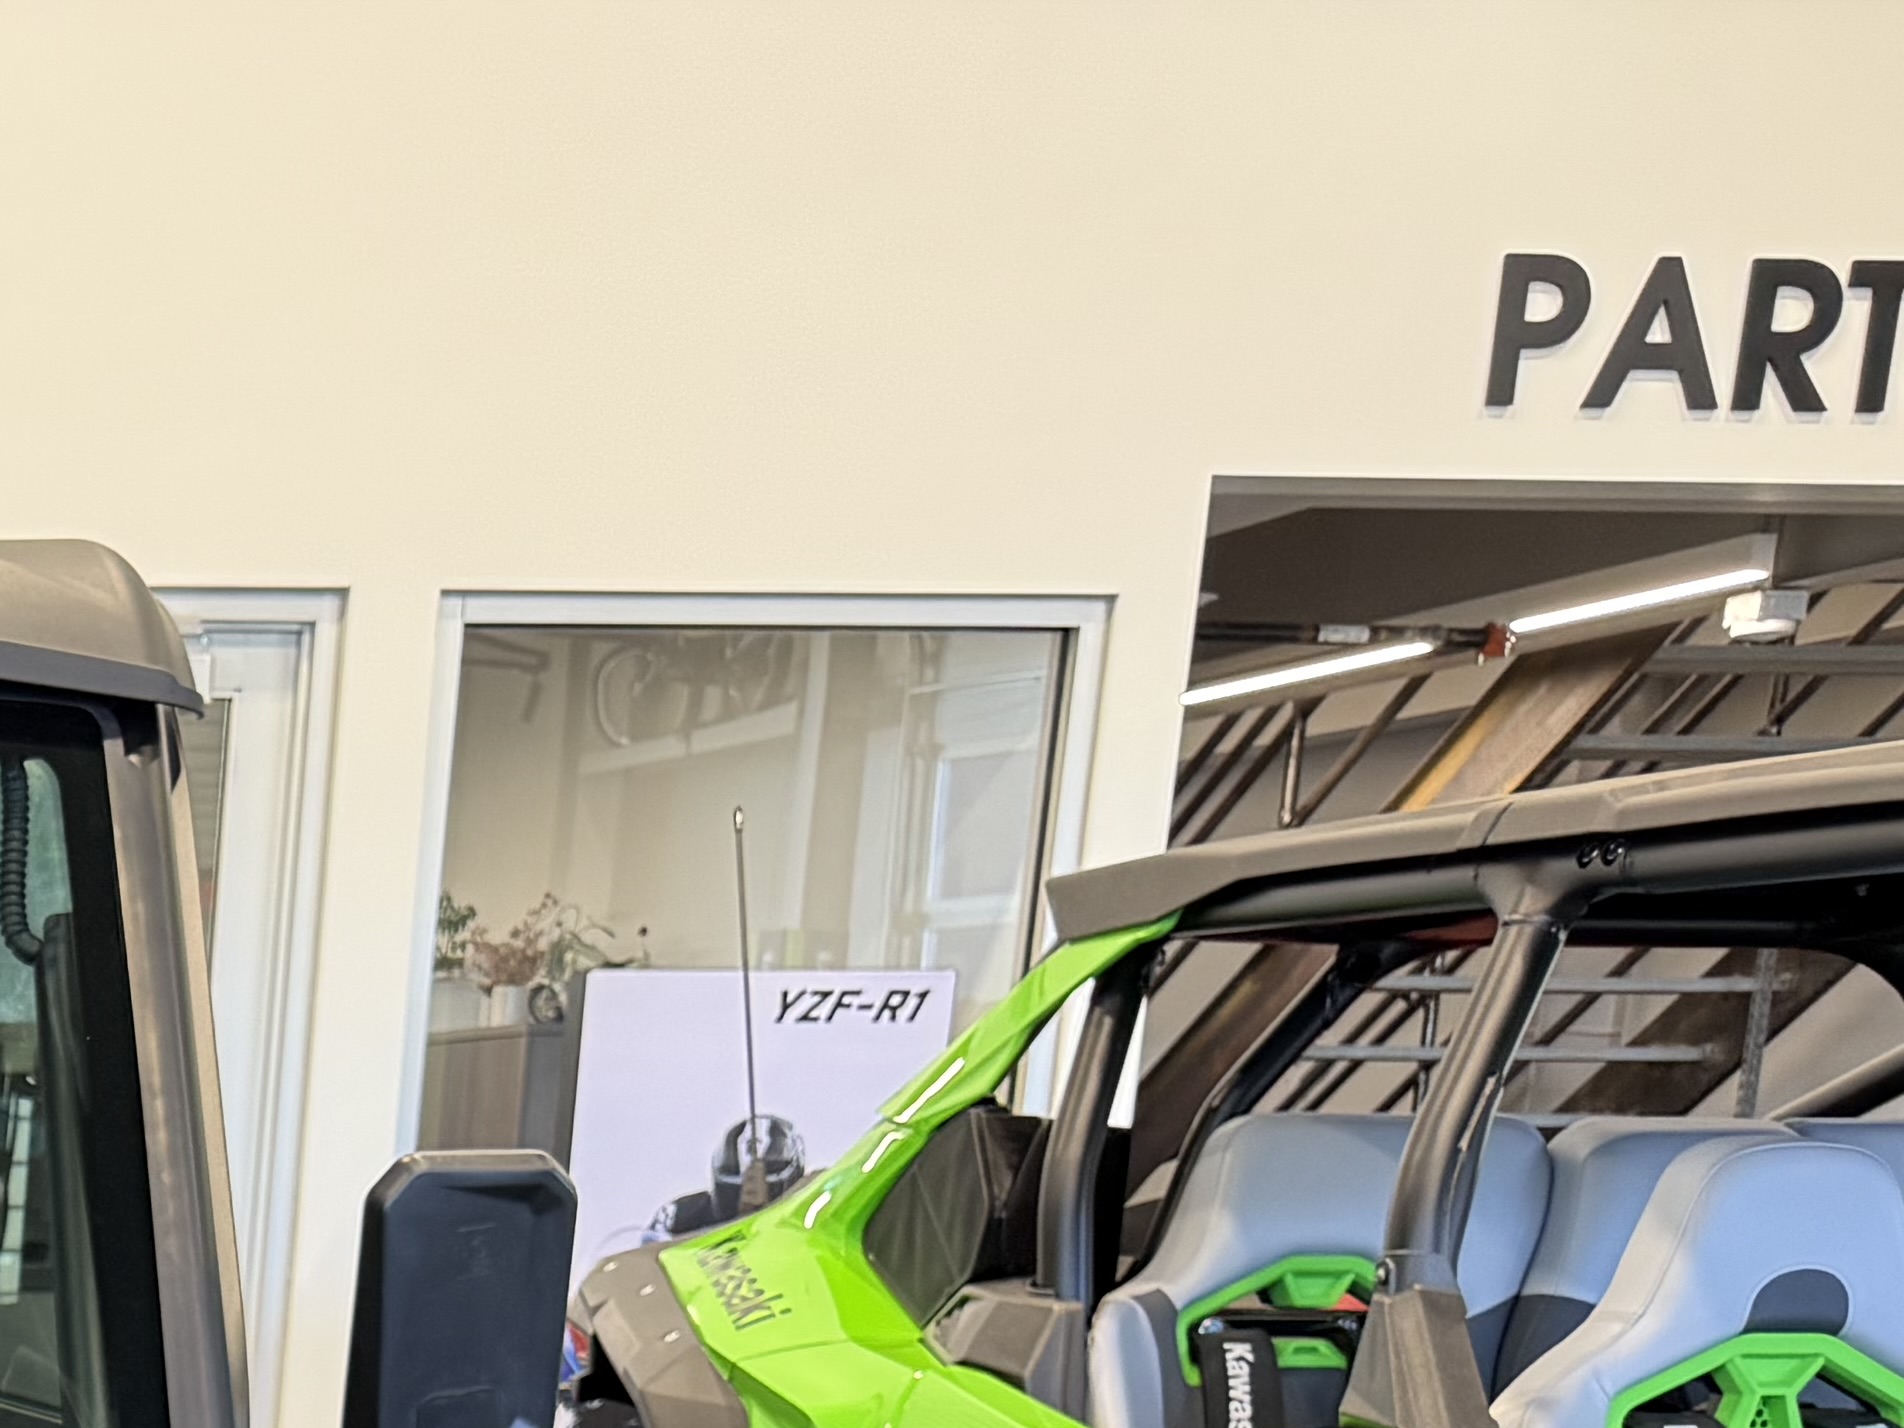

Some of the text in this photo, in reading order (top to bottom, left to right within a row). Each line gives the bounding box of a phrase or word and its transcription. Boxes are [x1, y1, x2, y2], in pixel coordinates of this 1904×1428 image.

[1485, 253, 1904, 415] PART
[775, 988, 931, 1024] YZF-R1
[695, 1228, 792, 1332] Kawasaki
